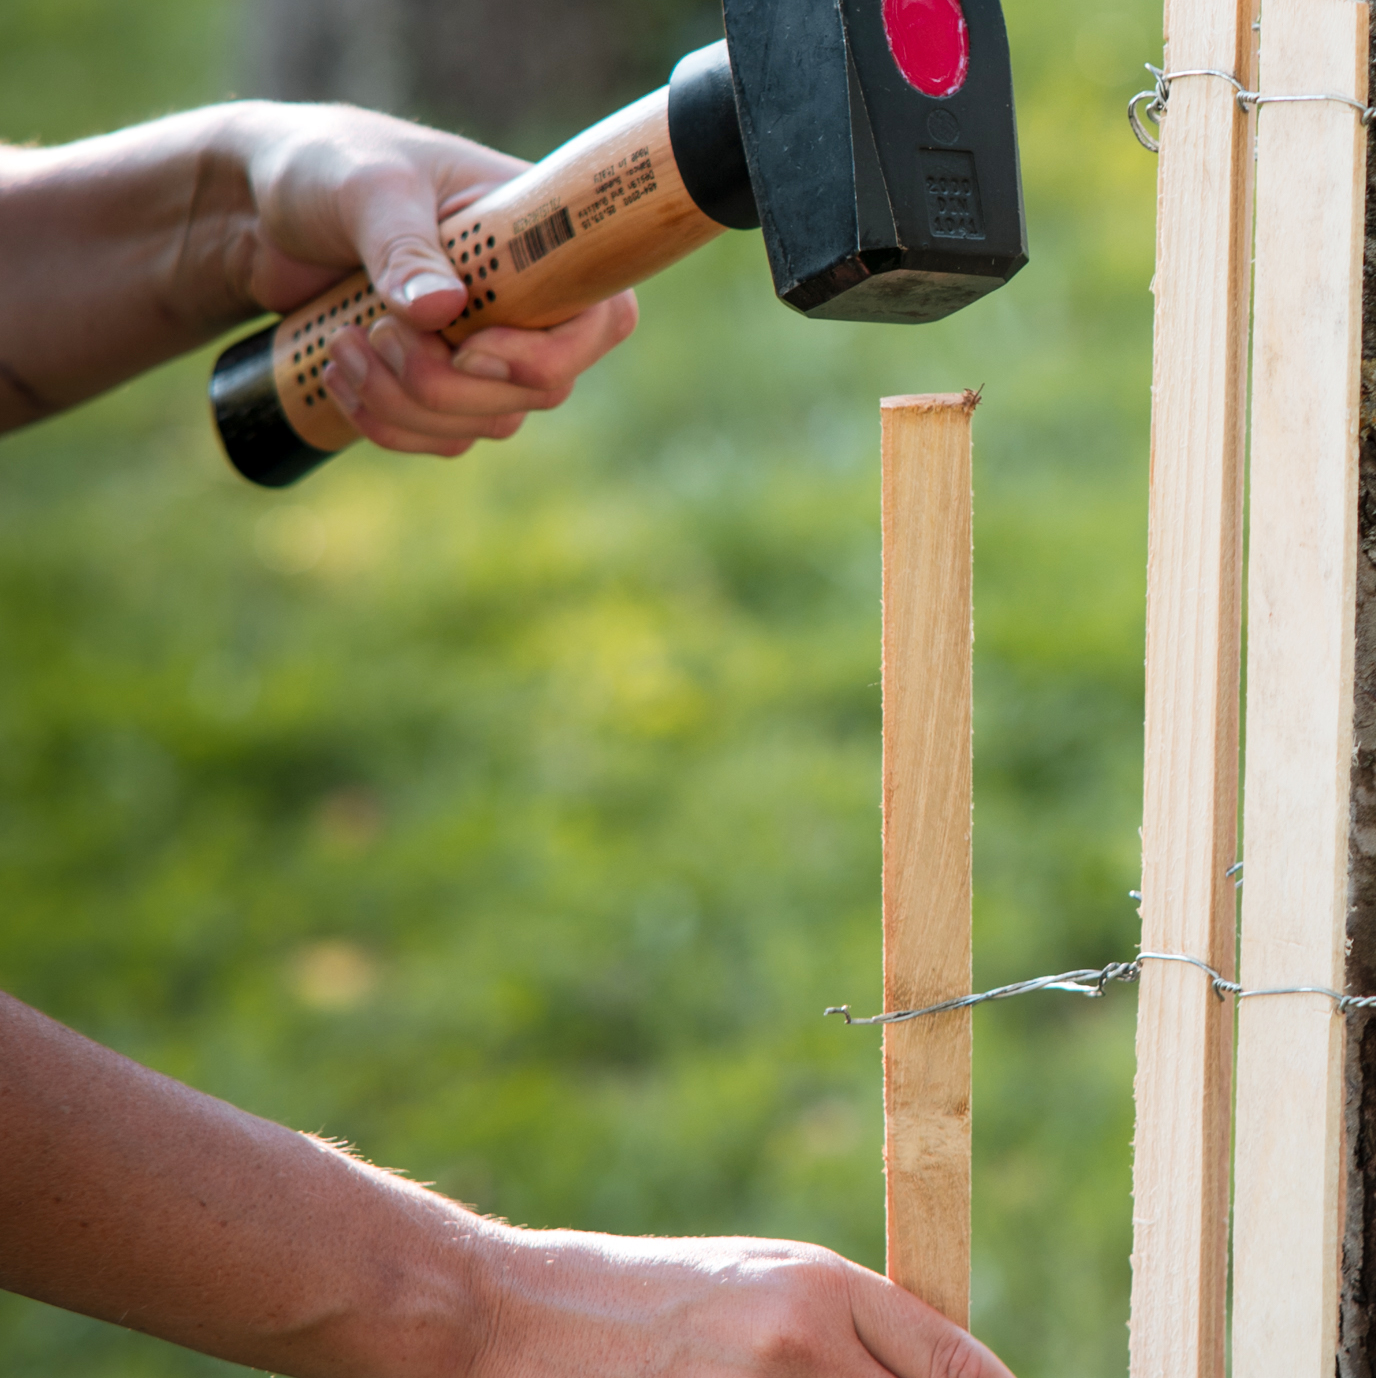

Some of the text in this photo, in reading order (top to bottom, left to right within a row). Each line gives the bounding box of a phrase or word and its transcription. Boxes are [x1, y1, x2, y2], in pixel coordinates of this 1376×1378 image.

[593, 145, 649, 183] Made in Italy
[627, 169, 655, 190] Design
[926, 175, 971, 195] 2000
[610, 187, 625, 201] and
[578, 196, 609, 219] Quality
[936, 196, 970, 215] DIN
